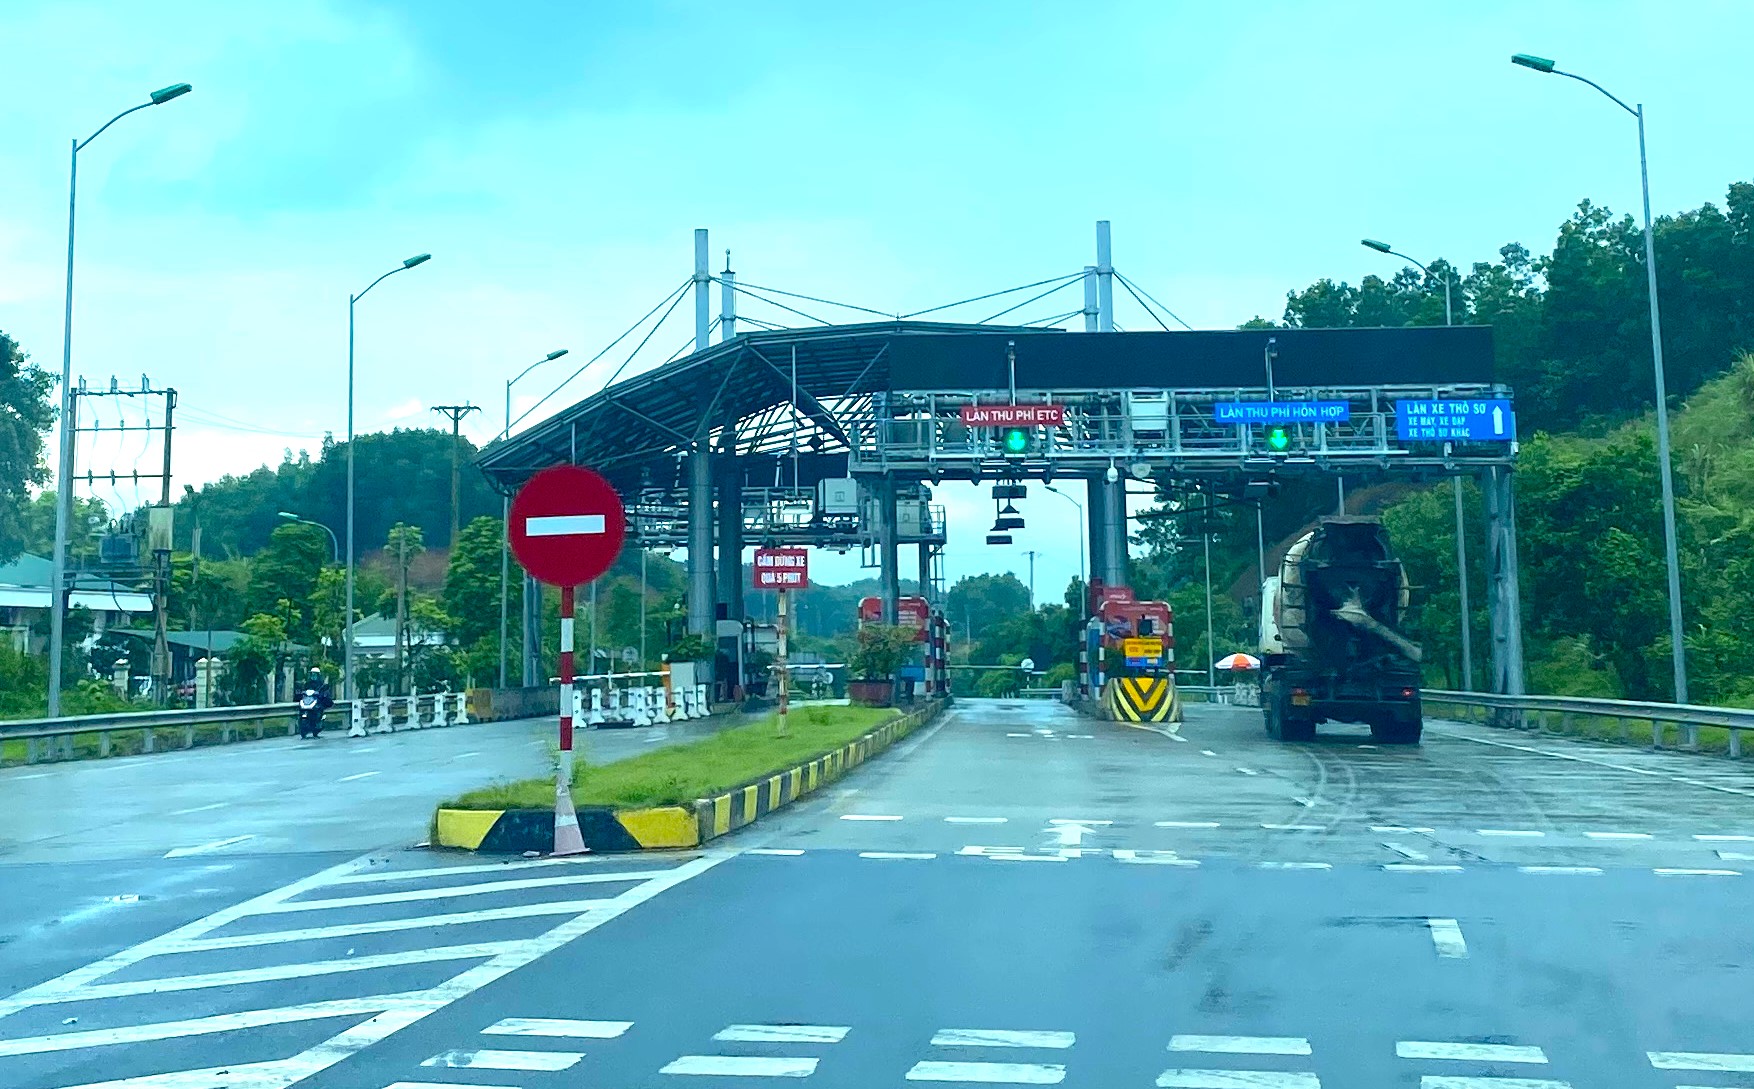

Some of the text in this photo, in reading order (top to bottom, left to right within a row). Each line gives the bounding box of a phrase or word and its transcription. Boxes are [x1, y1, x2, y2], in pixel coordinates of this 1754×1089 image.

[1220, 404, 1244, 418] LÀN
[1246, 407, 1269, 418] THU
[1271, 404, 1290, 418] PHÍ
[1320, 406, 1344, 418] HỢP
[1407, 401, 1427, 414] LÀN
[1431, 403, 1444, 414] XE
[966, 406, 1058, 422] LÀN THU PHÍ ETC
[1408, 416, 1418, 426] XE
[1439, 416, 1449, 426] XE
[1408, 427, 1418, 438] XE
[795, 555, 805, 567] XE
[776, 572, 782, 584] 5
